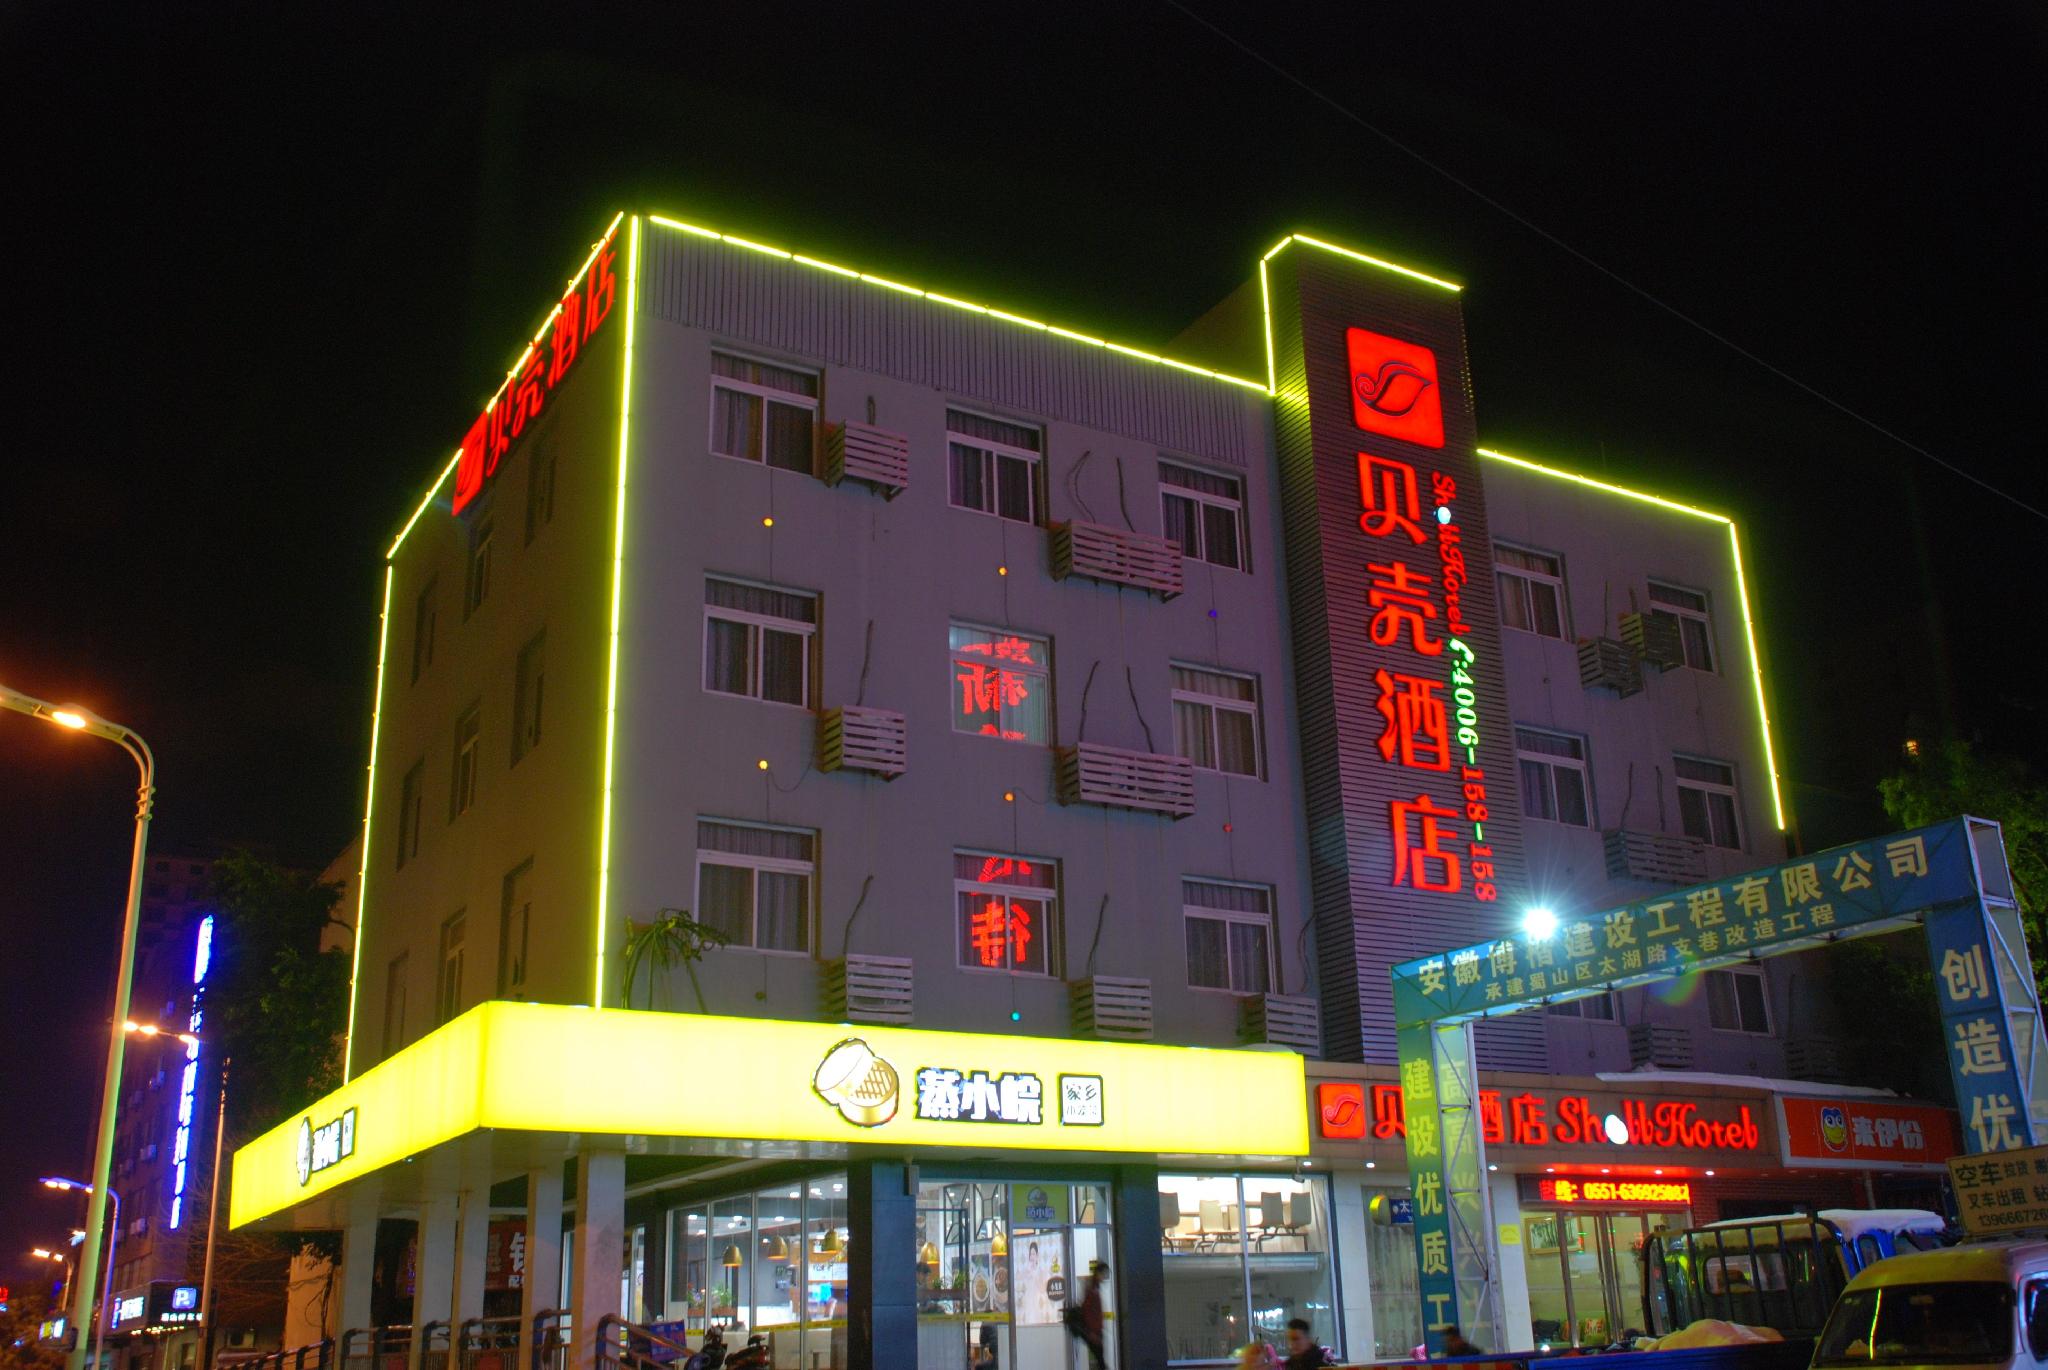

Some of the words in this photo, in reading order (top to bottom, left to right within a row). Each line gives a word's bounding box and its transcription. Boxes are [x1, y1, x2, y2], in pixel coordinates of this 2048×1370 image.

[1357, 451, 1462, 893] 贝壳酒店
[1485, 903, 1836, 1001] 承建蜀山区太湖路支巷改造工程
[1404, 1058, 1455, 1359] 建设优质工
[1556, 1096, 1654, 1145] Shll
